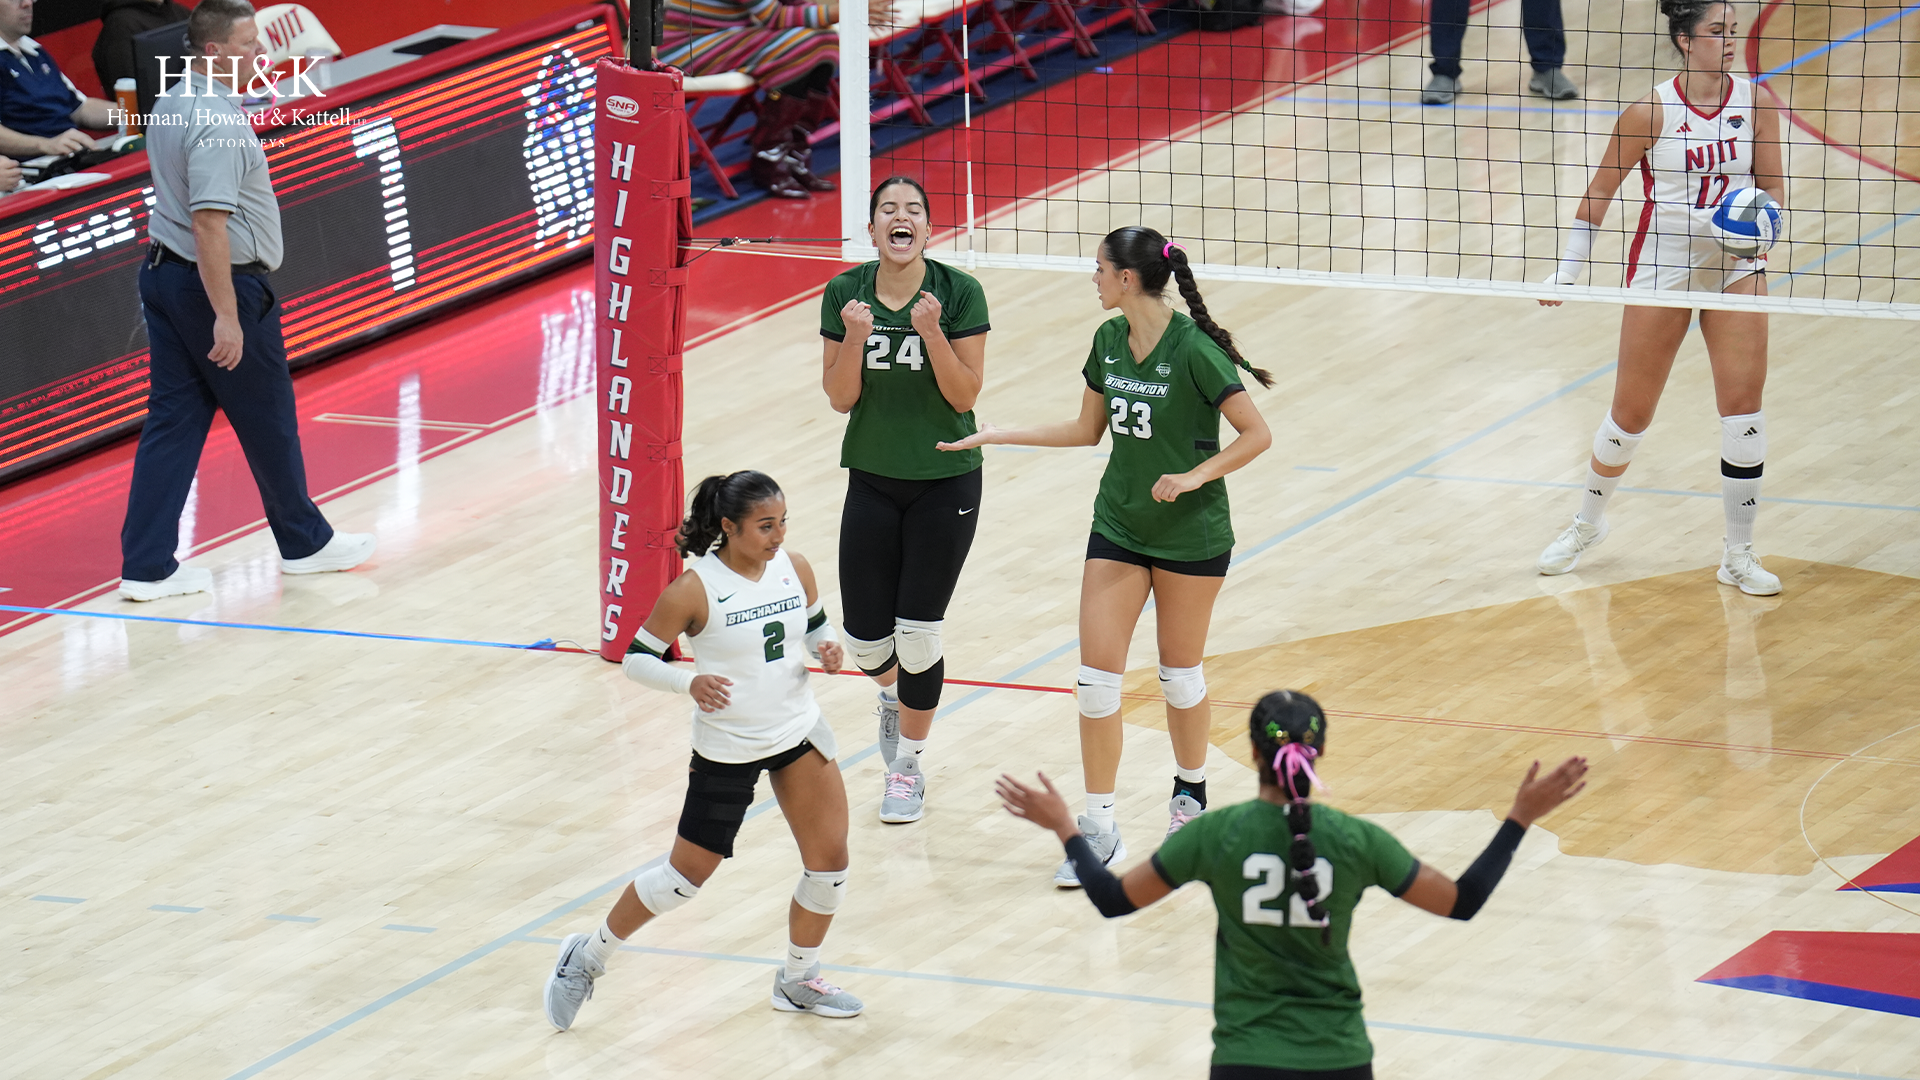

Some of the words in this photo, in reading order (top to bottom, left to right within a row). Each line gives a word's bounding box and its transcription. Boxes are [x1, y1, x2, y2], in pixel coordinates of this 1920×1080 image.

[264, 6, 305, 51] NJIT
[607, 98, 636, 112] SNA
[1685, 136, 1738, 173] NJIT
[866, 333, 924, 371] 24
[602, 140, 636, 642] HIGHLANDERS
[1104, 375, 1168, 396] BINGHAMTON
[1110, 396, 1153, 440] 23
[726, 596, 801, 626] BINGHAMTON
[762, 620, 785, 663] 2
[1242, 852, 1334, 928] 22
